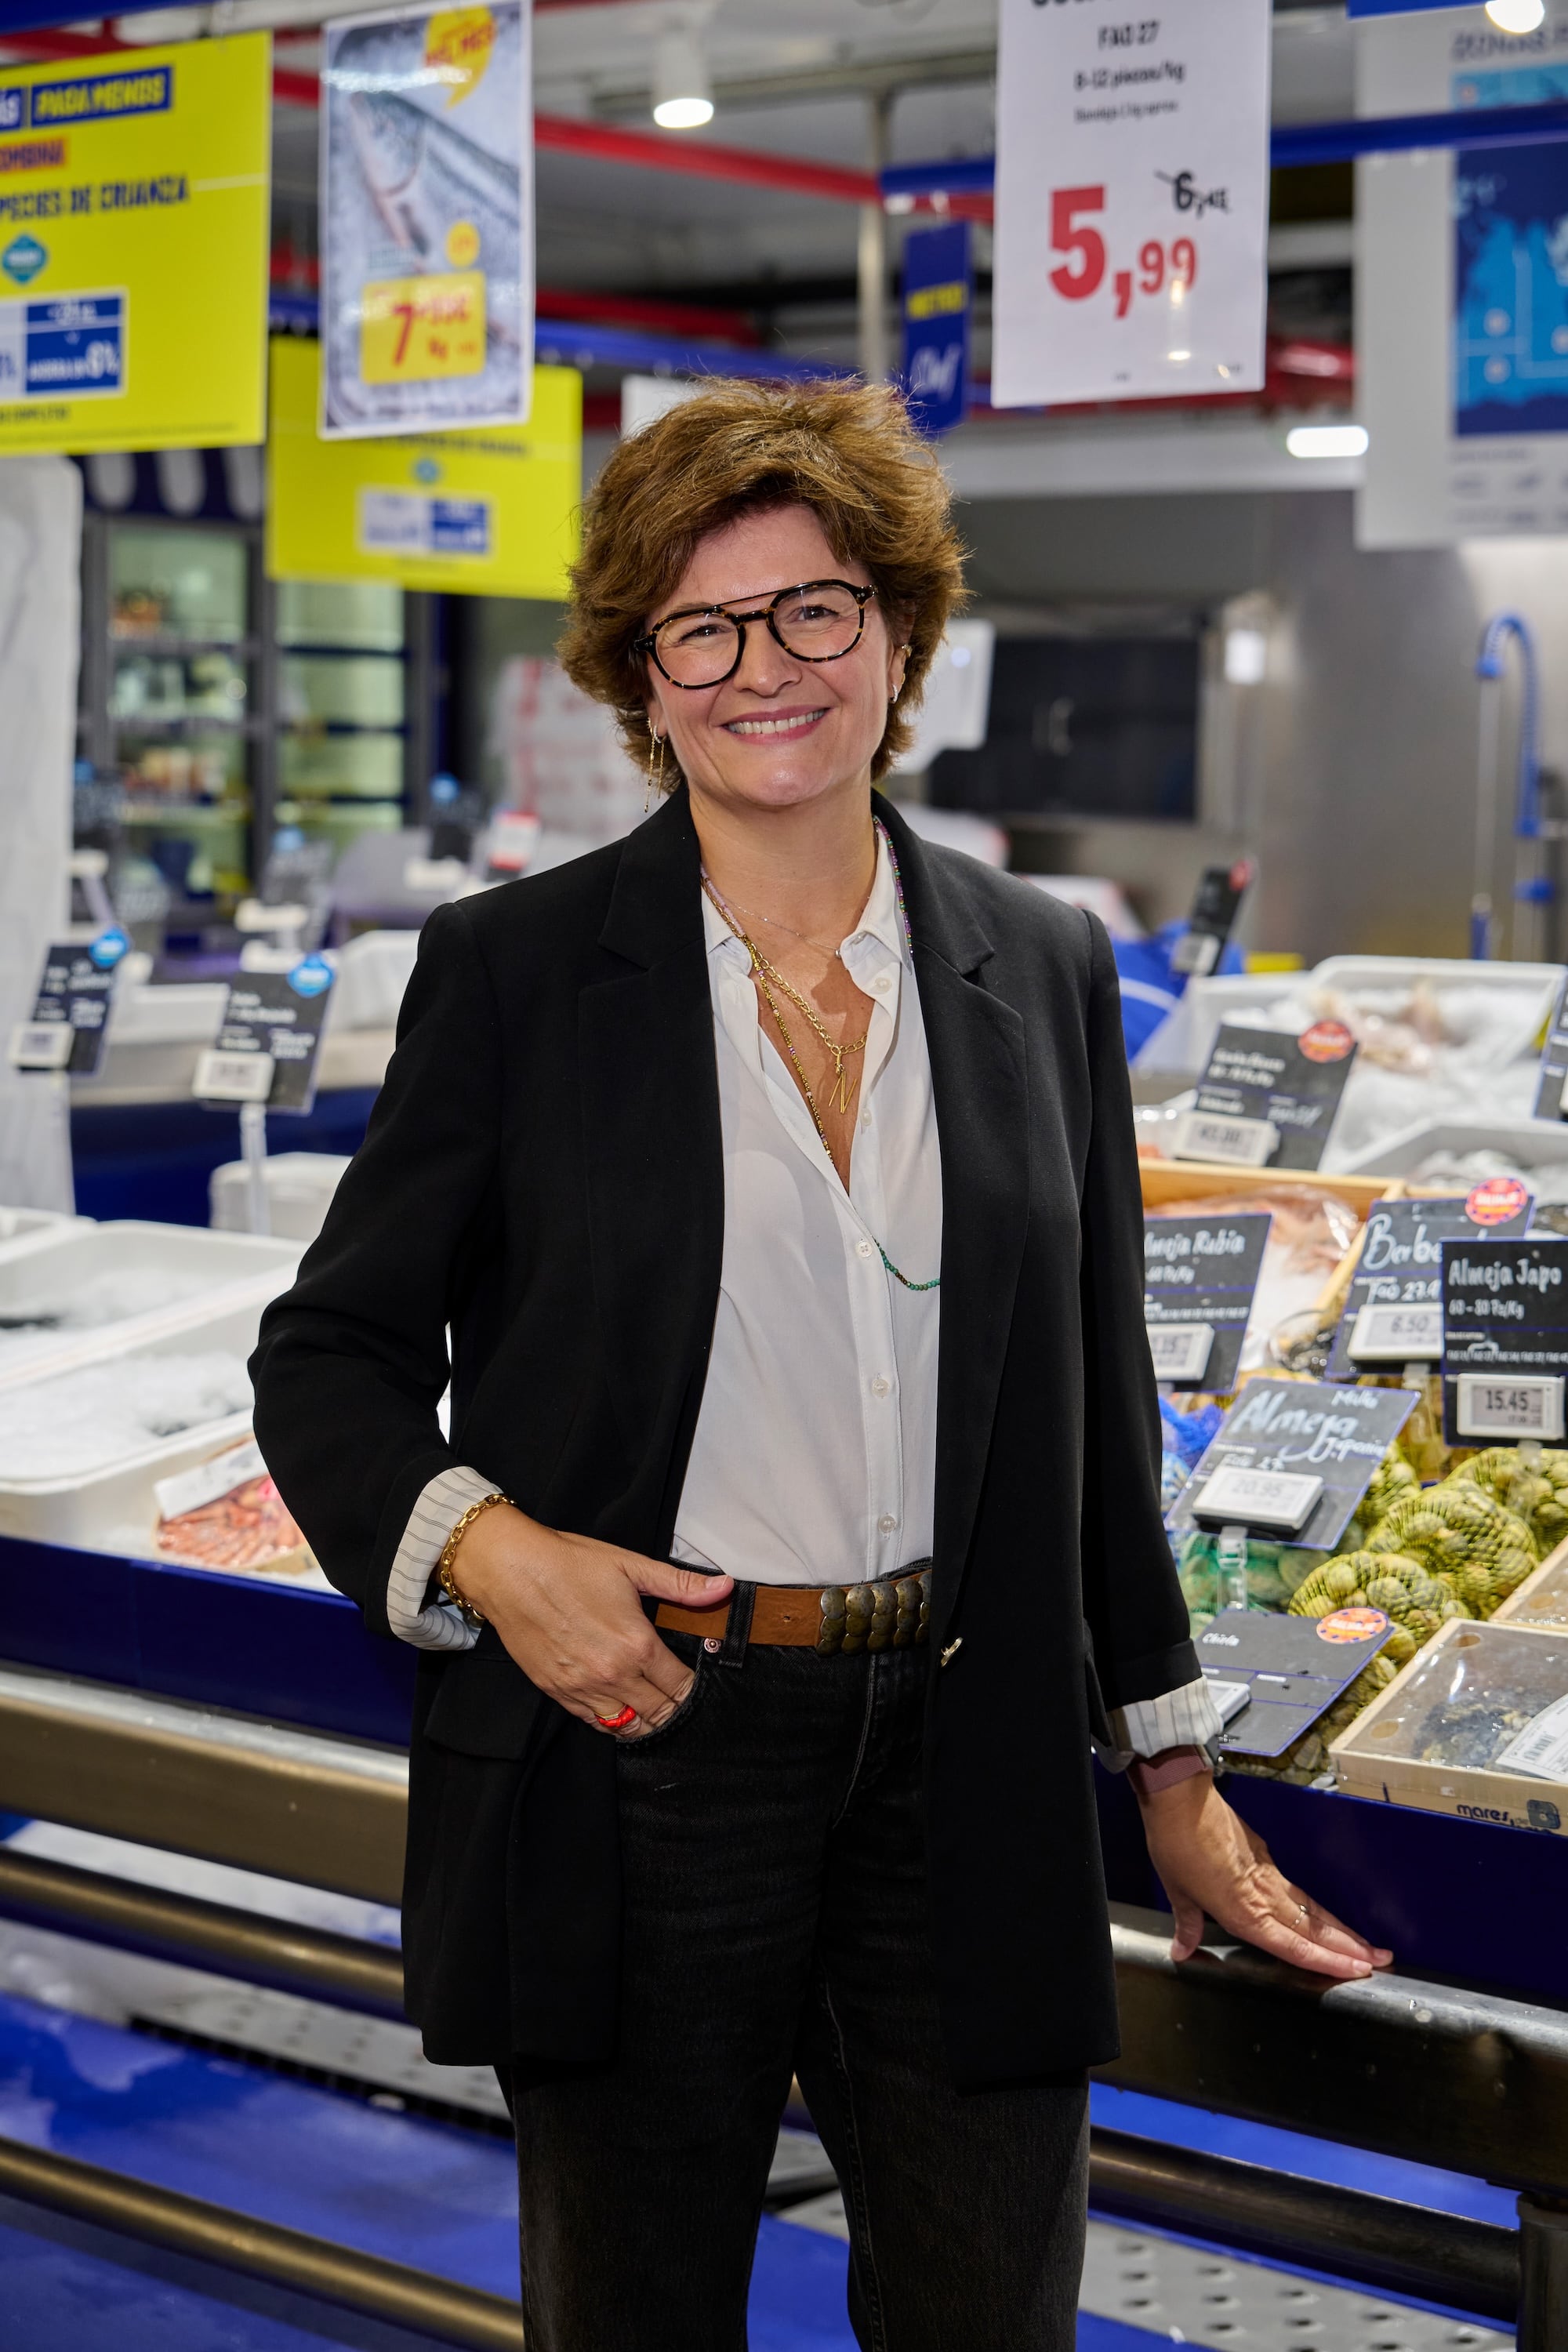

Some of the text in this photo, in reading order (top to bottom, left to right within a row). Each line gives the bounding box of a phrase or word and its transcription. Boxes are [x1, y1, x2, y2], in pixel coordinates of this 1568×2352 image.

[1049, 183, 1197, 320] 5,99
[1448, 1257, 1563, 1294] Almeja Japo
[1486, 1389, 1529, 1411] 15.45
